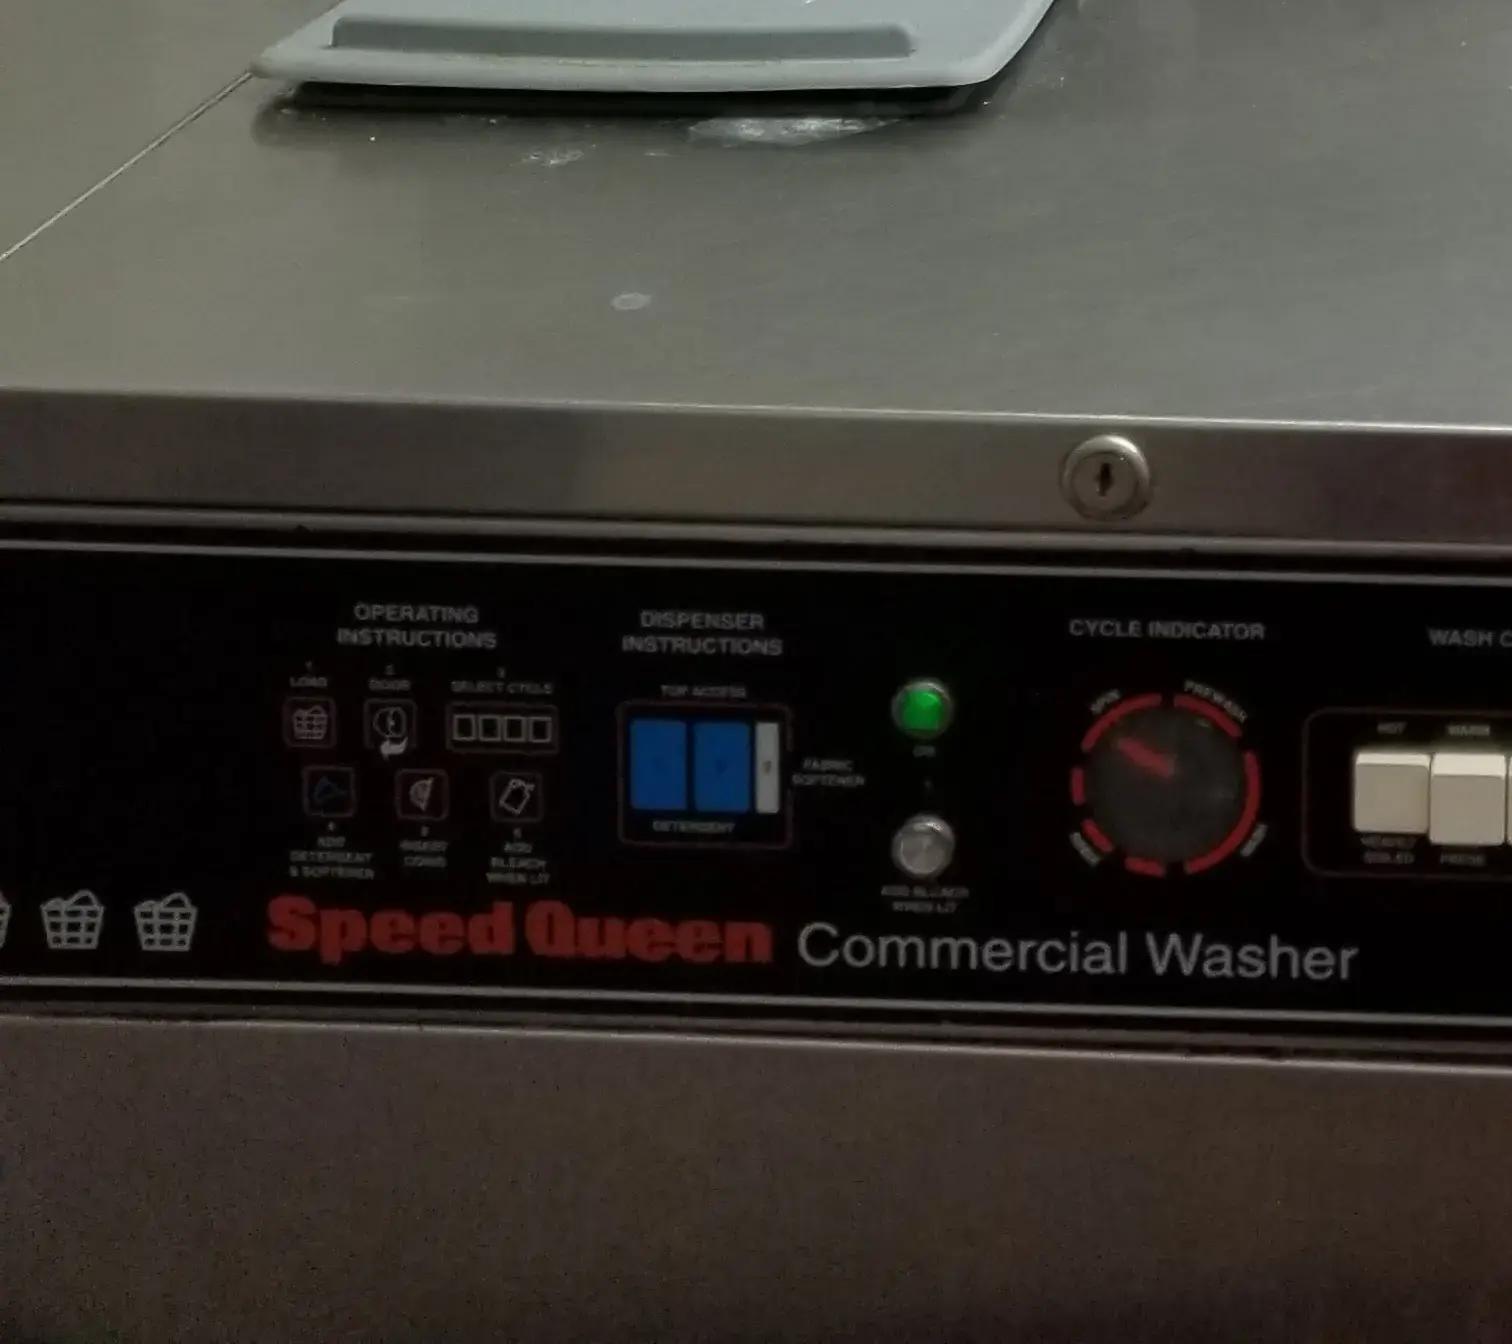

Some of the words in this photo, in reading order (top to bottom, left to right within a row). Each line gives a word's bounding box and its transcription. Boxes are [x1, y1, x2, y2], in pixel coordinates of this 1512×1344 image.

[353, 603, 479, 624] OPERATING
[640, 610, 764, 630] DISPENSER
[337, 628, 497, 649] INSTRUCTIONS
[1069, 619, 1141, 638] CYCLE
[1148, 620, 1265, 640] INDICATOR
[1429, 629, 1493, 647] WASH
[622, 635, 783, 656] INSTRUCTIONS
[267, 894, 515, 965] Speed
[525, 899, 774, 963] Queen
[797, 921, 1128, 975] Commercial
[1146, 932, 1359, 981] Washer
